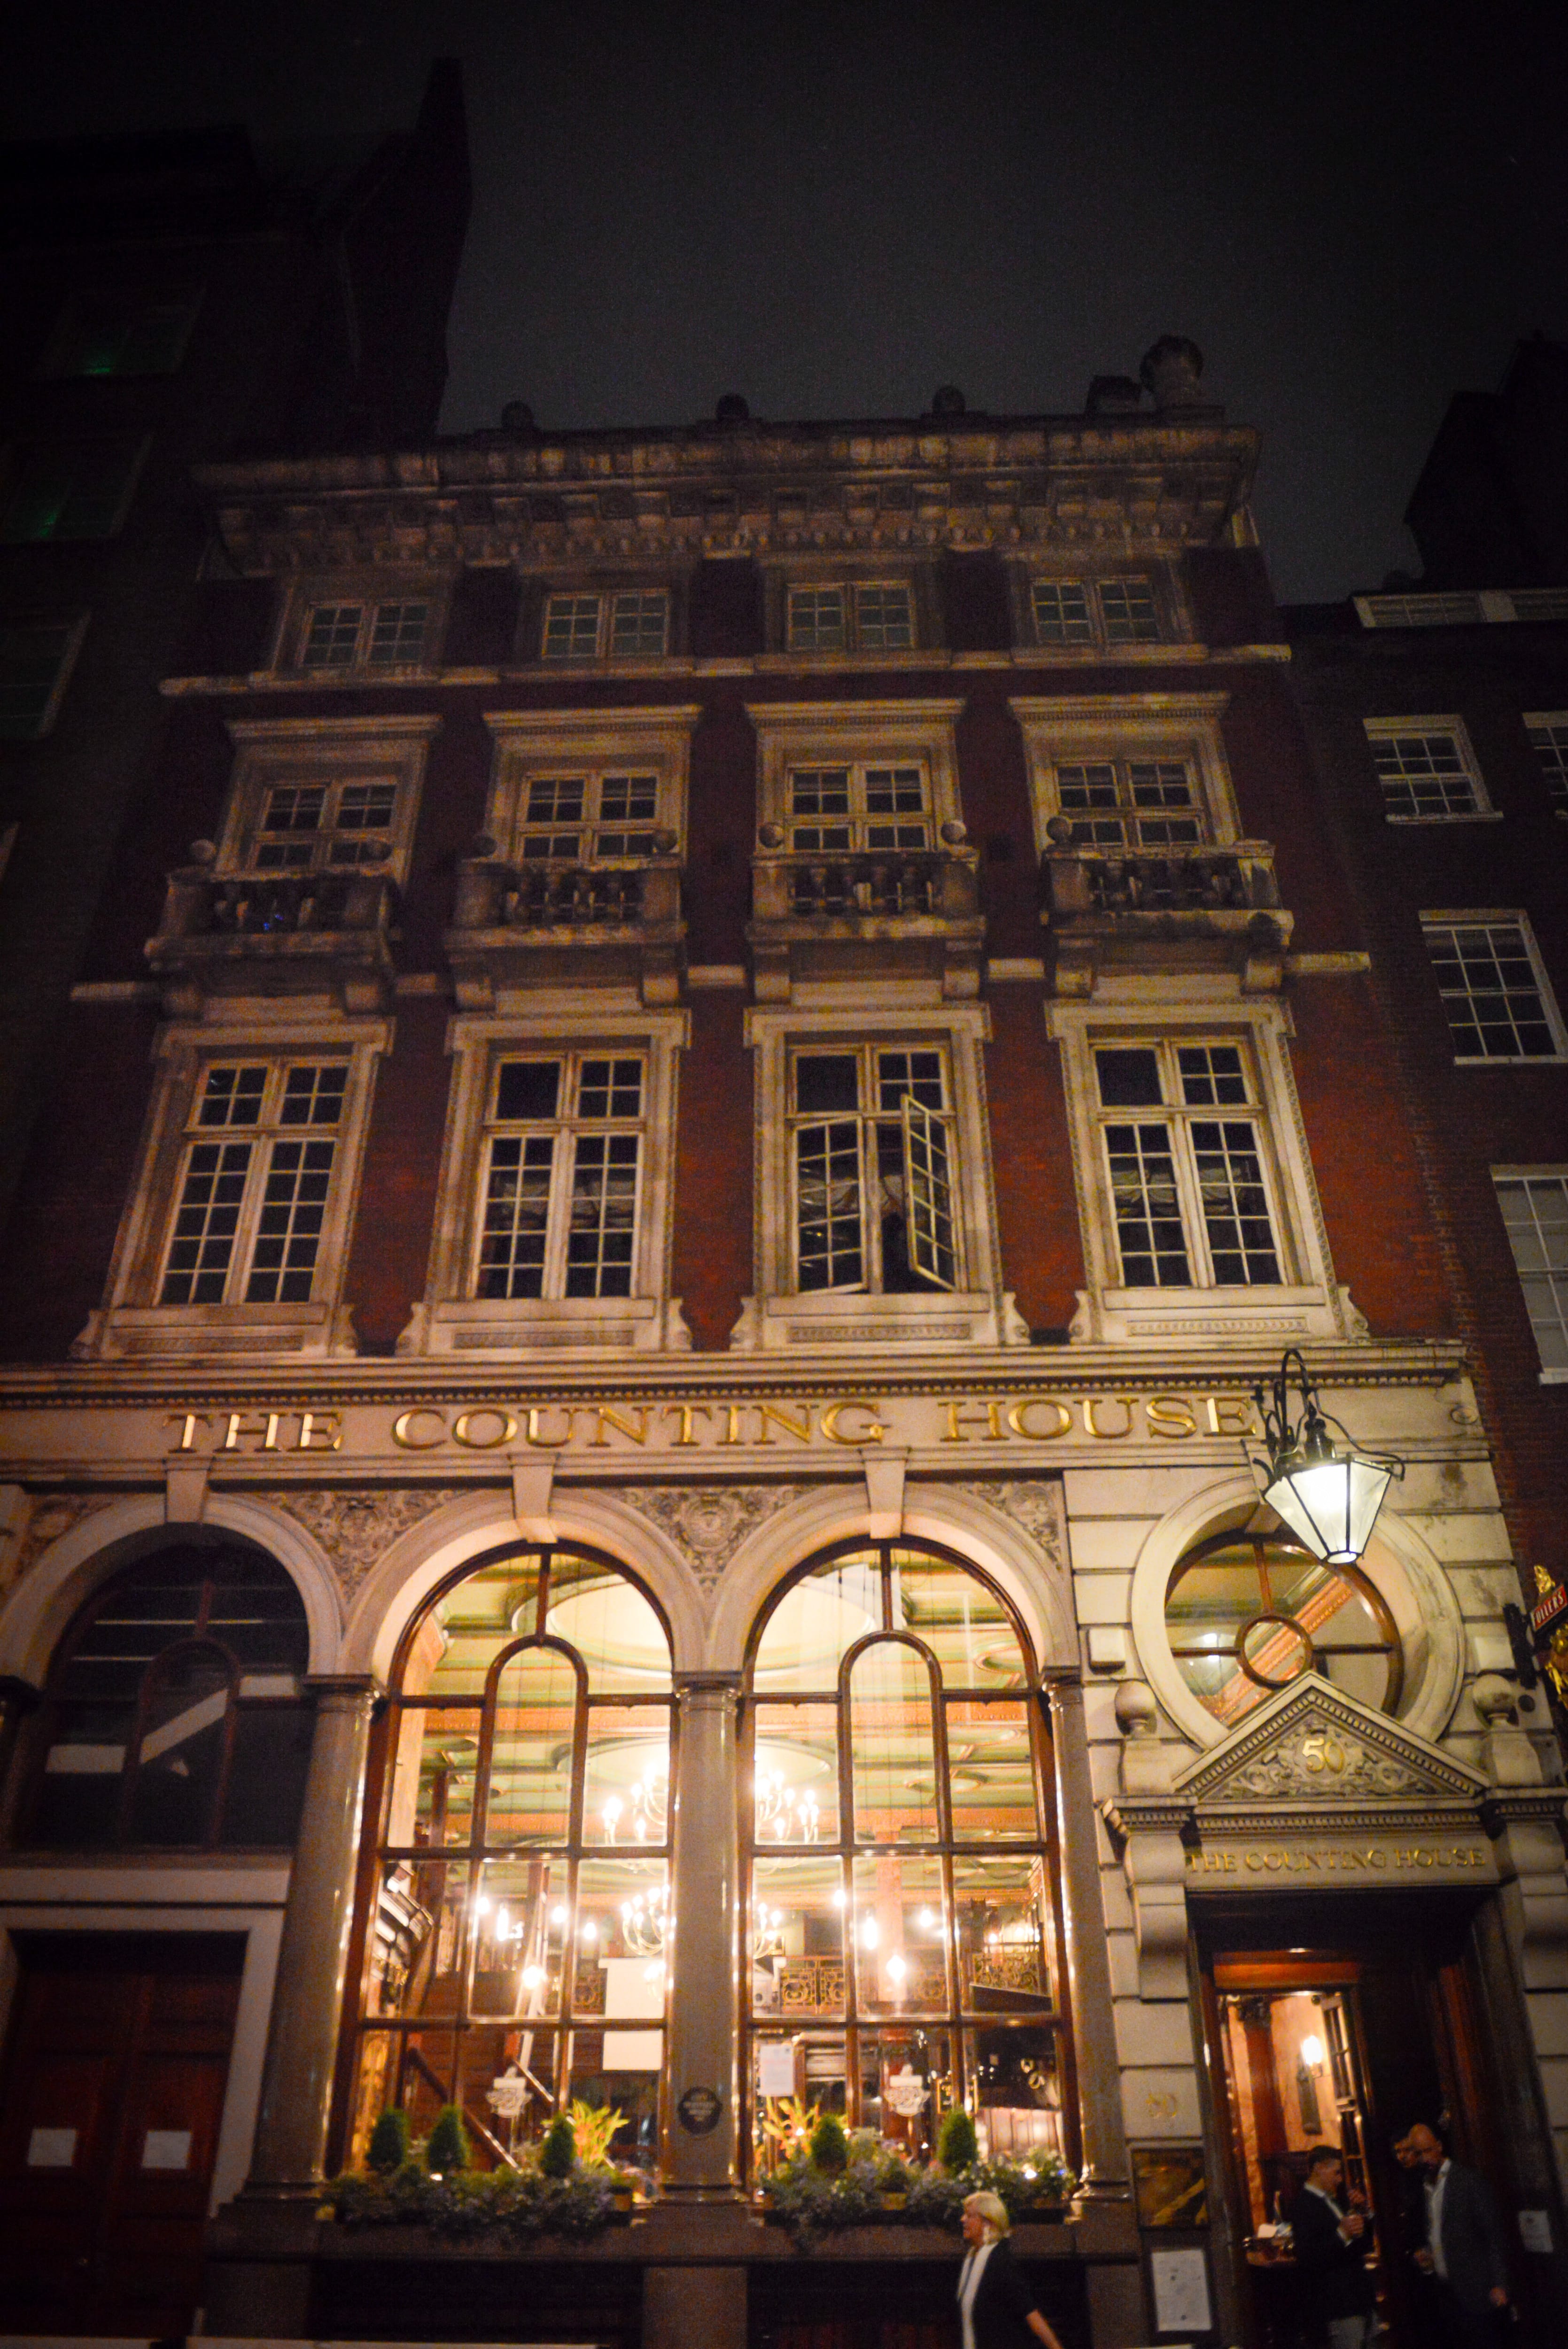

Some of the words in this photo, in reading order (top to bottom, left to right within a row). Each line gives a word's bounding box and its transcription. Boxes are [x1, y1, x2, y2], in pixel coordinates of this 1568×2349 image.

[163, 1411, 343, 1454] THE
[391, 1401, 891, 1450] COUNTING
[938, 1396, 1256, 1443] HOUSE
[1302, 1737, 1345, 1773] 50
[1185, 1852, 1237, 1872] THE
[1244, 1849, 1387, 1872] COUNTING
[1394, 1848, 1485, 1868] HOUSE
